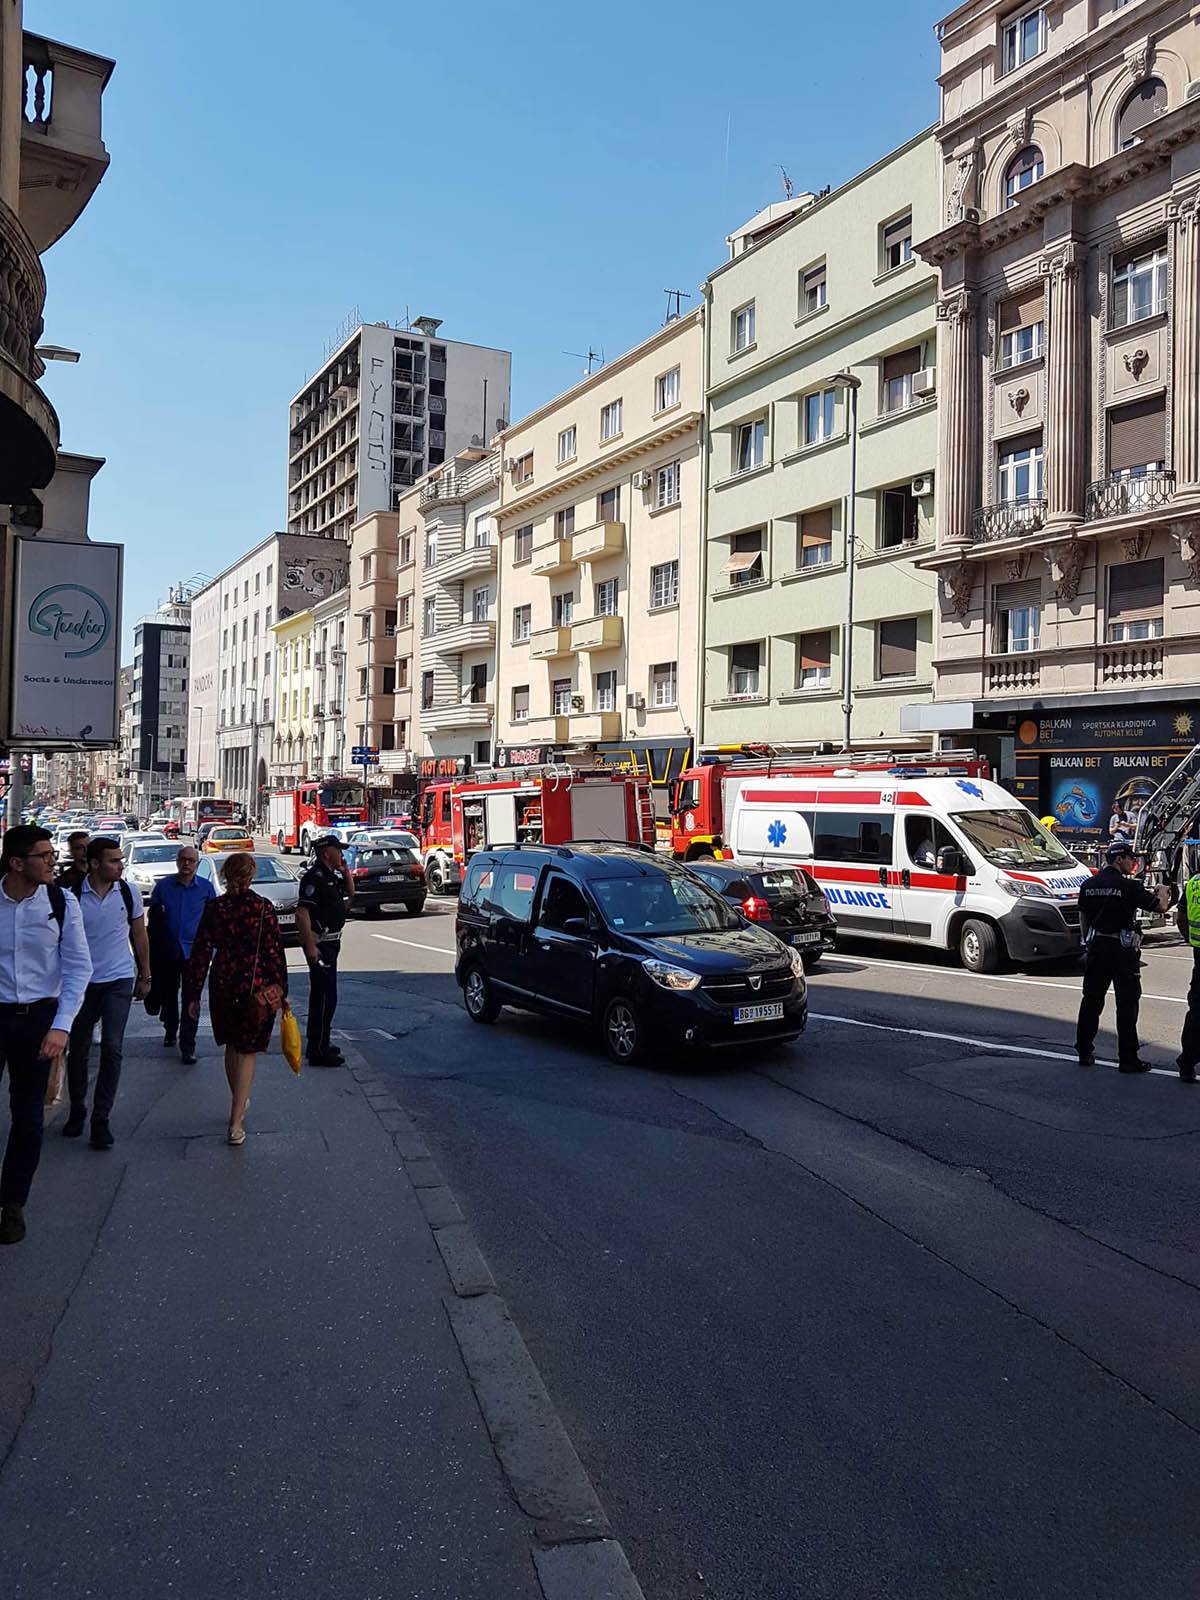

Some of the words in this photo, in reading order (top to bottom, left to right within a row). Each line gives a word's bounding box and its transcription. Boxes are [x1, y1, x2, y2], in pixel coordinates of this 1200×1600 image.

[36, 603, 105, 641] Studio
[1039, 718, 1072, 730] BALKAN
[1082, 720, 1116, 730] SPORTSKA
[1116, 718, 1157, 729] KLADIONICA
[1039, 728, 1057, 739] BET
[1093, 728, 1125, 738] AUTOMAT
[1125, 727, 1144, 737] KLUB
[421, 759, 437, 775] SLOT
[1050, 757, 1084, 768] BALKAN
[1084, 756, 1102, 768] BET
[1113, 756, 1151, 768] BALKAN
[1151, 755, 1169, 768] BET
[881, 793, 893, 803] 42
